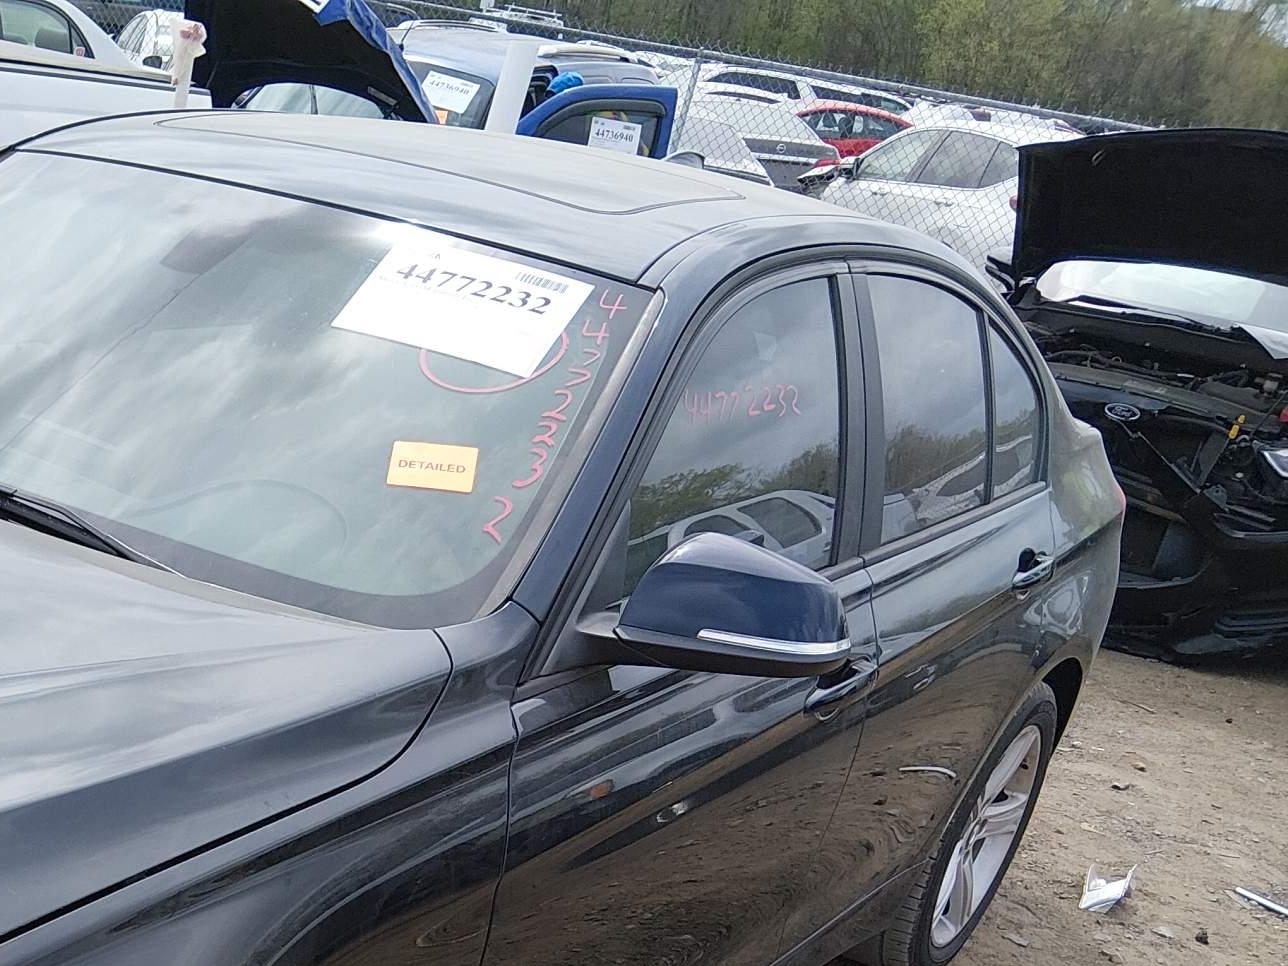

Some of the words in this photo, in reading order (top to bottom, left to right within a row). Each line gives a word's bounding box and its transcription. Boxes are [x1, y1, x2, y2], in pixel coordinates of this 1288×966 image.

[595, 129, 634, 142] 44736940
[397, 264, 551, 315] 44772232
[482, 289, 627, 544] 44772232
[684, 384, 801, 424] 44772232
[398, 459, 466, 473] DETAILED
